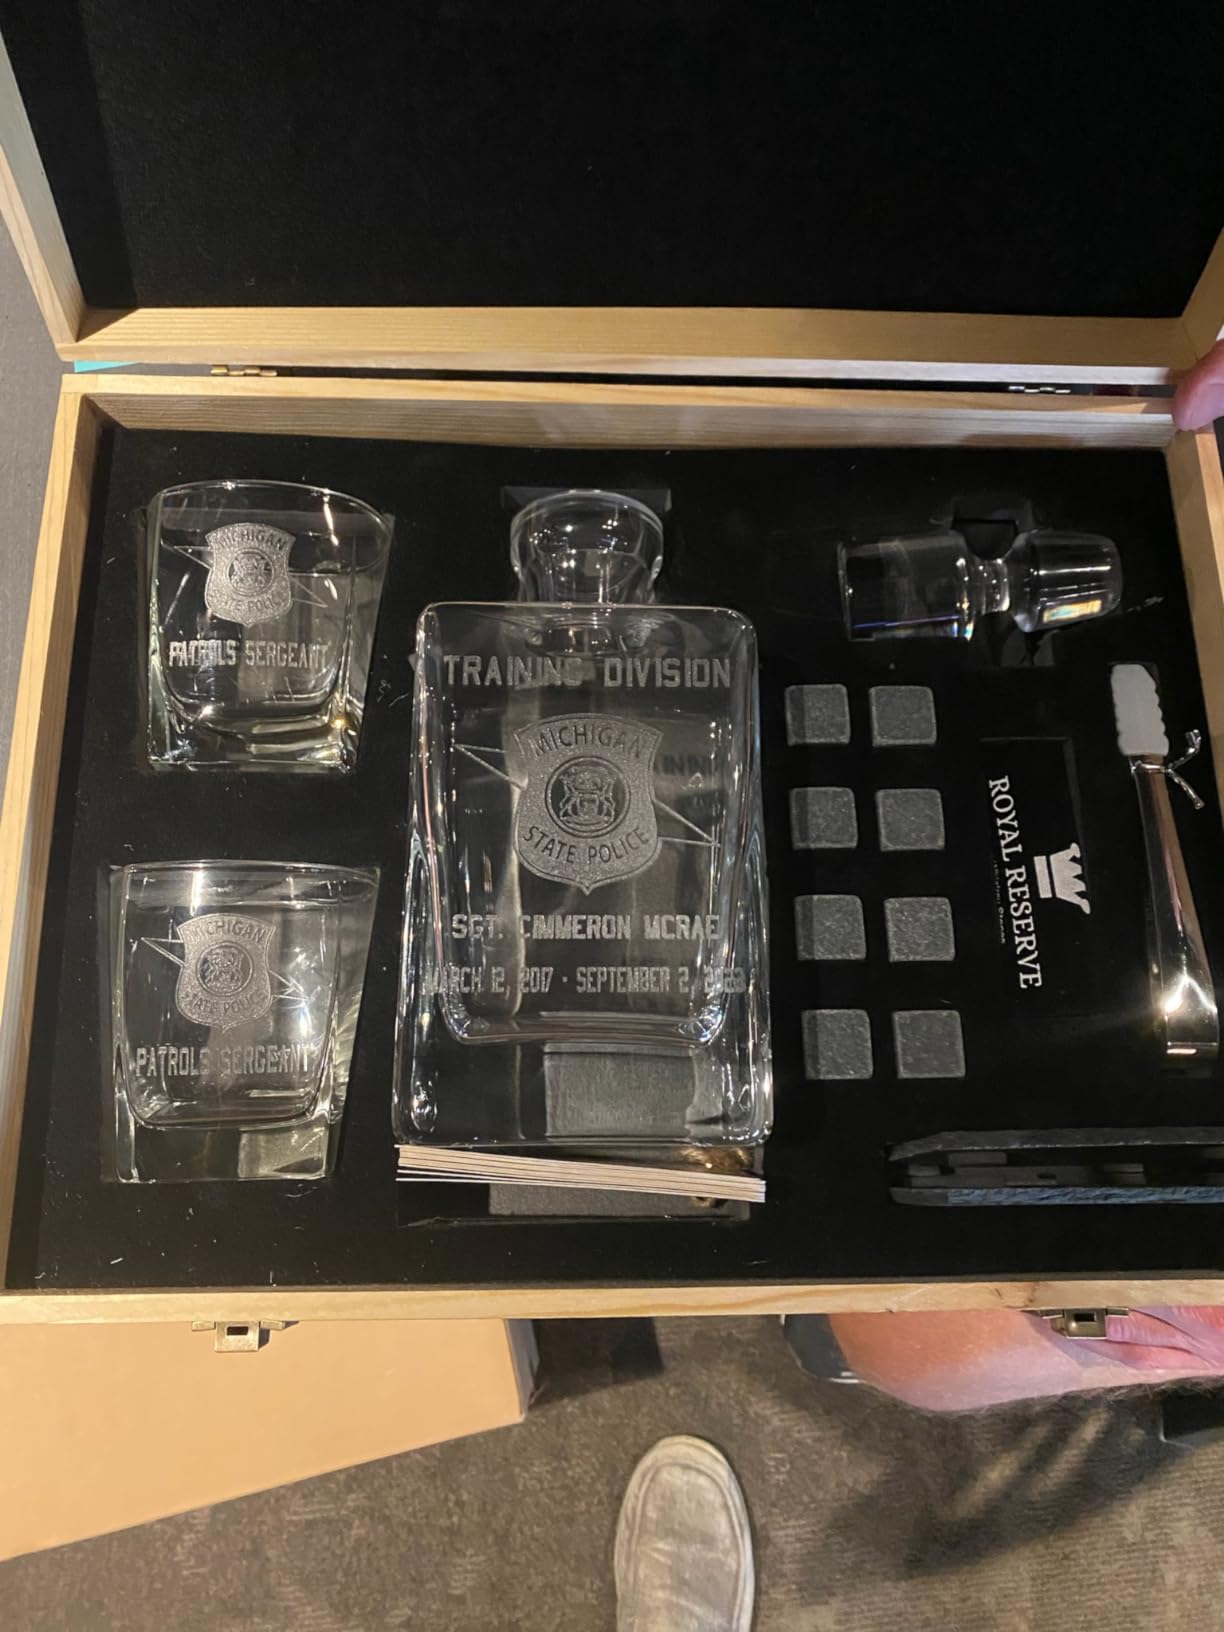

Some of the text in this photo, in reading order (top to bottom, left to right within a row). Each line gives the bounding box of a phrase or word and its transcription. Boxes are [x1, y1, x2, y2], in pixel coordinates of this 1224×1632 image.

[245, 639, 332, 669] SERGEANT
[443, 654, 731, 689] TRAINING DIVISION
[528, 724, 643, 759] MICHIGAN
[522, 825, 649, 866] STATE POLICE
[988, 775, 1043, 989] ROYAL RESERVE
[451, 913, 721, 941] SGT. CIMMERON MCRAE
[519, 966, 554, 993] 2017
[575, 966, 671, 993] SEPTEMBER
[135, 1043, 315, 1078] PATROLS SERGEANT
